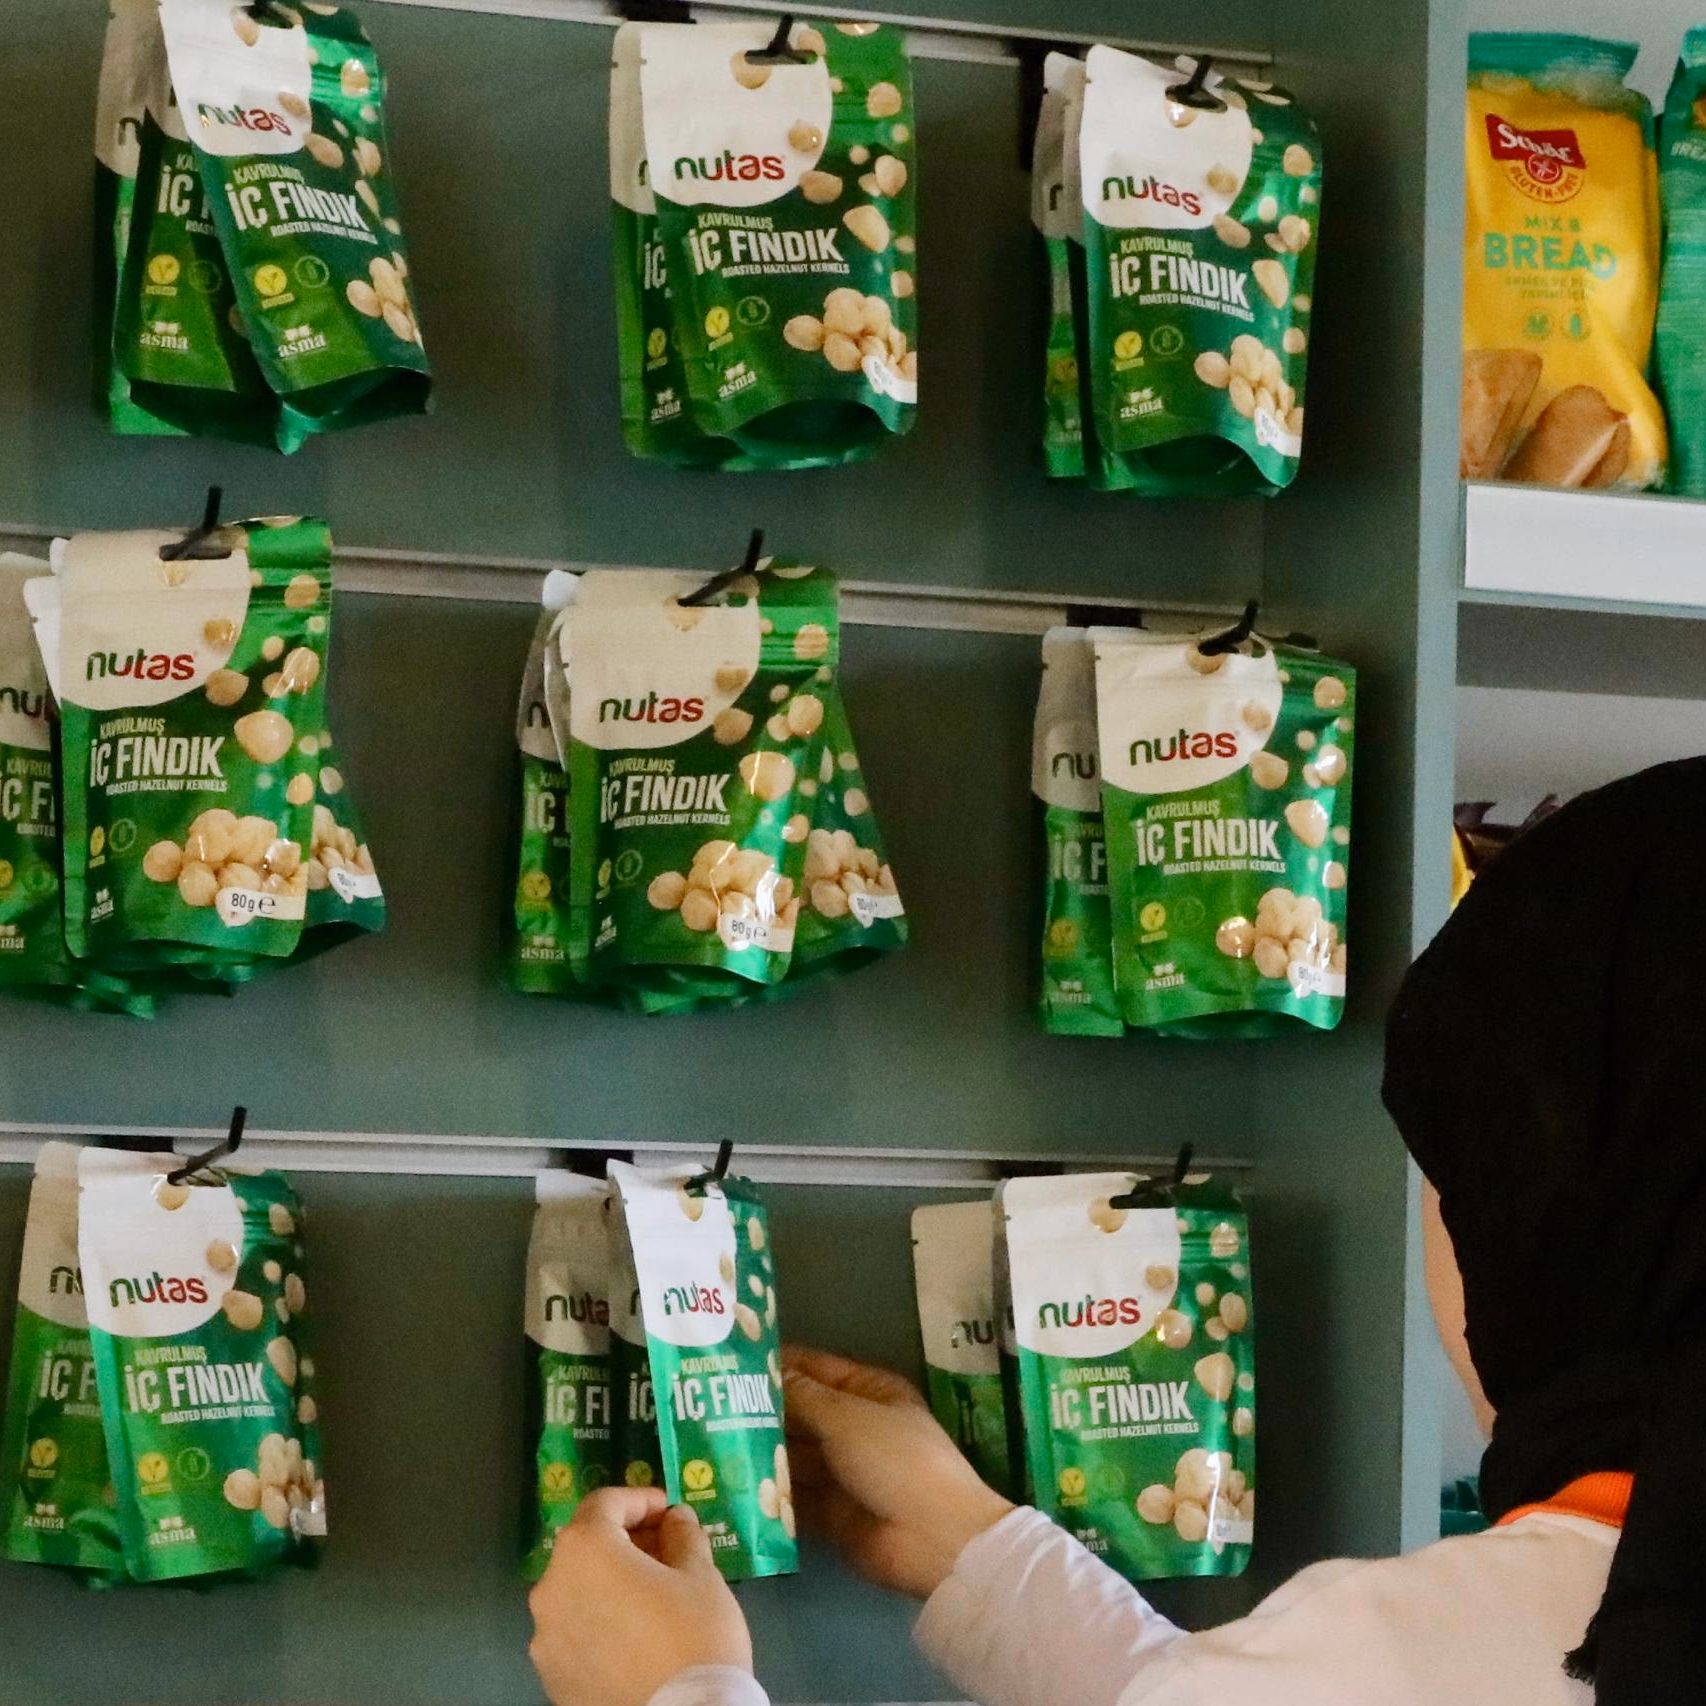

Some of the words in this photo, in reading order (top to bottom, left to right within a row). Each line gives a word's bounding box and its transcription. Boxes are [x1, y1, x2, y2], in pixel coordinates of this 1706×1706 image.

[674, 149, 785, 181] nutas
[271, 183, 371, 232] FINDIK
[1103, 175, 1203, 217] nutas
[730, 228, 844, 262] FINDIK
[1484, 232, 1617, 280] BREAD
[1150, 256, 1250, 308] FINDIK
[140, 328, 189, 353] asma
[277, 332, 328, 358] asma
[718, 369, 757, 400] asma
[1119, 397, 1164, 420] asma
[86, 648, 195, 682] nutas
[599, 690, 704, 724] nutas
[117, 735, 226, 780] FINDIK
[1130, 728, 1238, 767] nutas
[624, 774, 732, 813] FINDIK
[1174, 818, 1282, 860] FINDIK
[520, 946, 566, 962] asma
[1145, 972, 1187, 992] asma
[110, 1272, 208, 1308] nutas
[1038, 1294, 1142, 1331] nutas
[167, 1362, 272, 1408] FINDIK
[710, 1372, 776, 1416] FINDIK
[1090, 1381, 1195, 1425] FINDIK
[23, 1514, 65, 1530] asma
[148, 1526, 197, 1546] asma
